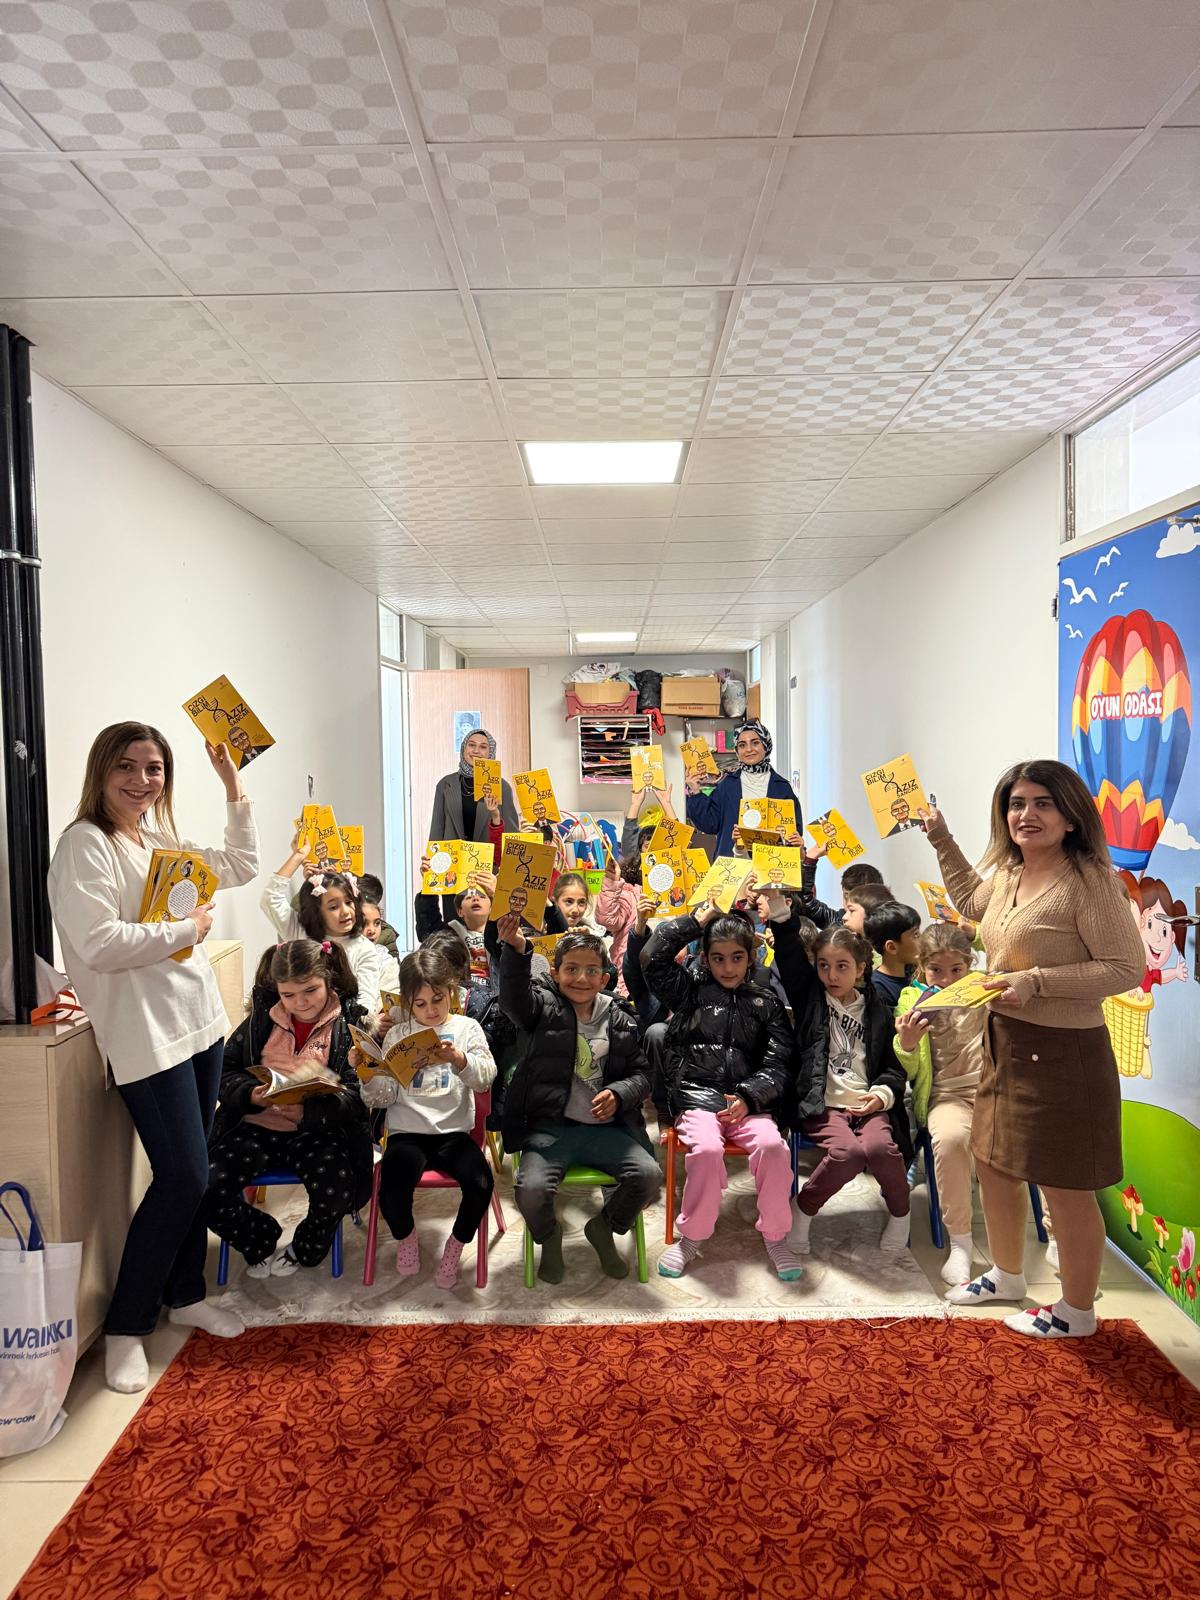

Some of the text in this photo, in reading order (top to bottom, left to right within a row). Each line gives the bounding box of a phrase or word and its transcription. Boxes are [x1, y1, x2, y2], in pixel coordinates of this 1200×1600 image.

[227, 702, 247, 723] AZİZ
[1091, 690, 1163, 719] OYUN ODASI
[896, 778, 917, 794] AZİZ
[523, 874, 548, 887] AZİZ
